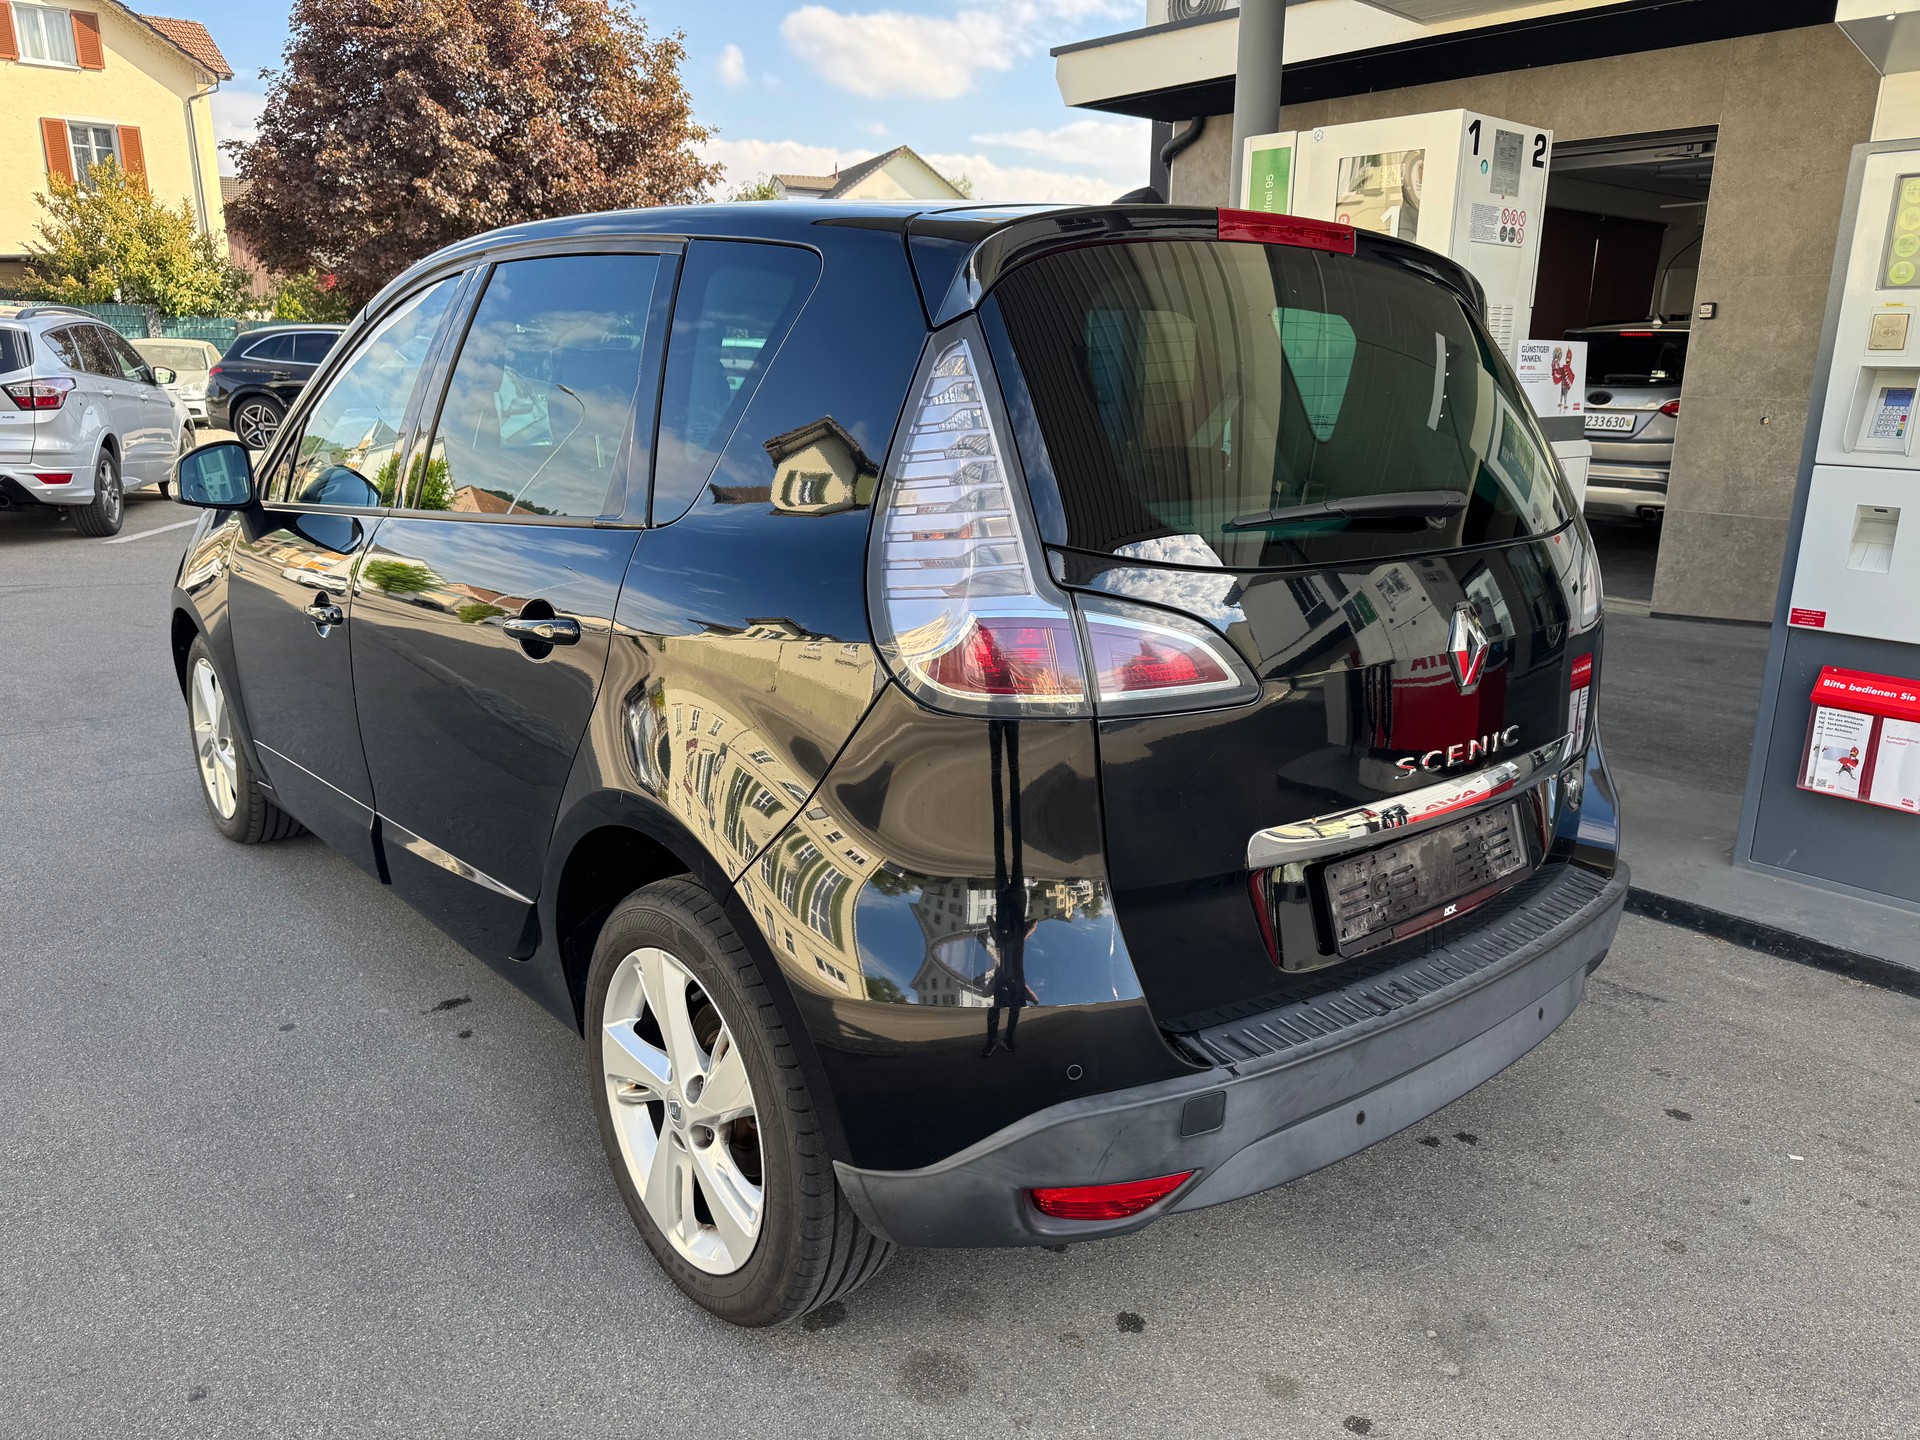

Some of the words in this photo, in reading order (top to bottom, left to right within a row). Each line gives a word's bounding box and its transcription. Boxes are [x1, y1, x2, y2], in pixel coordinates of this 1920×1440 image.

[1468, 119, 1481, 156] 1
[1532, 133, 1547, 169] 2
[1265, 173, 1274, 189] 95
[1521, 344, 1550, 354] GÜNSTIGER
[1521, 354, 1542, 363] TANKEN.
[1585, 415, 1626, 428] 233630
[1823, 679, 1846, 690] Bitte
[1848, 683, 1897, 699] bedienen
[1900, 692, 1917, 702] Sie
[1394, 724, 1519, 780] SCENIC
